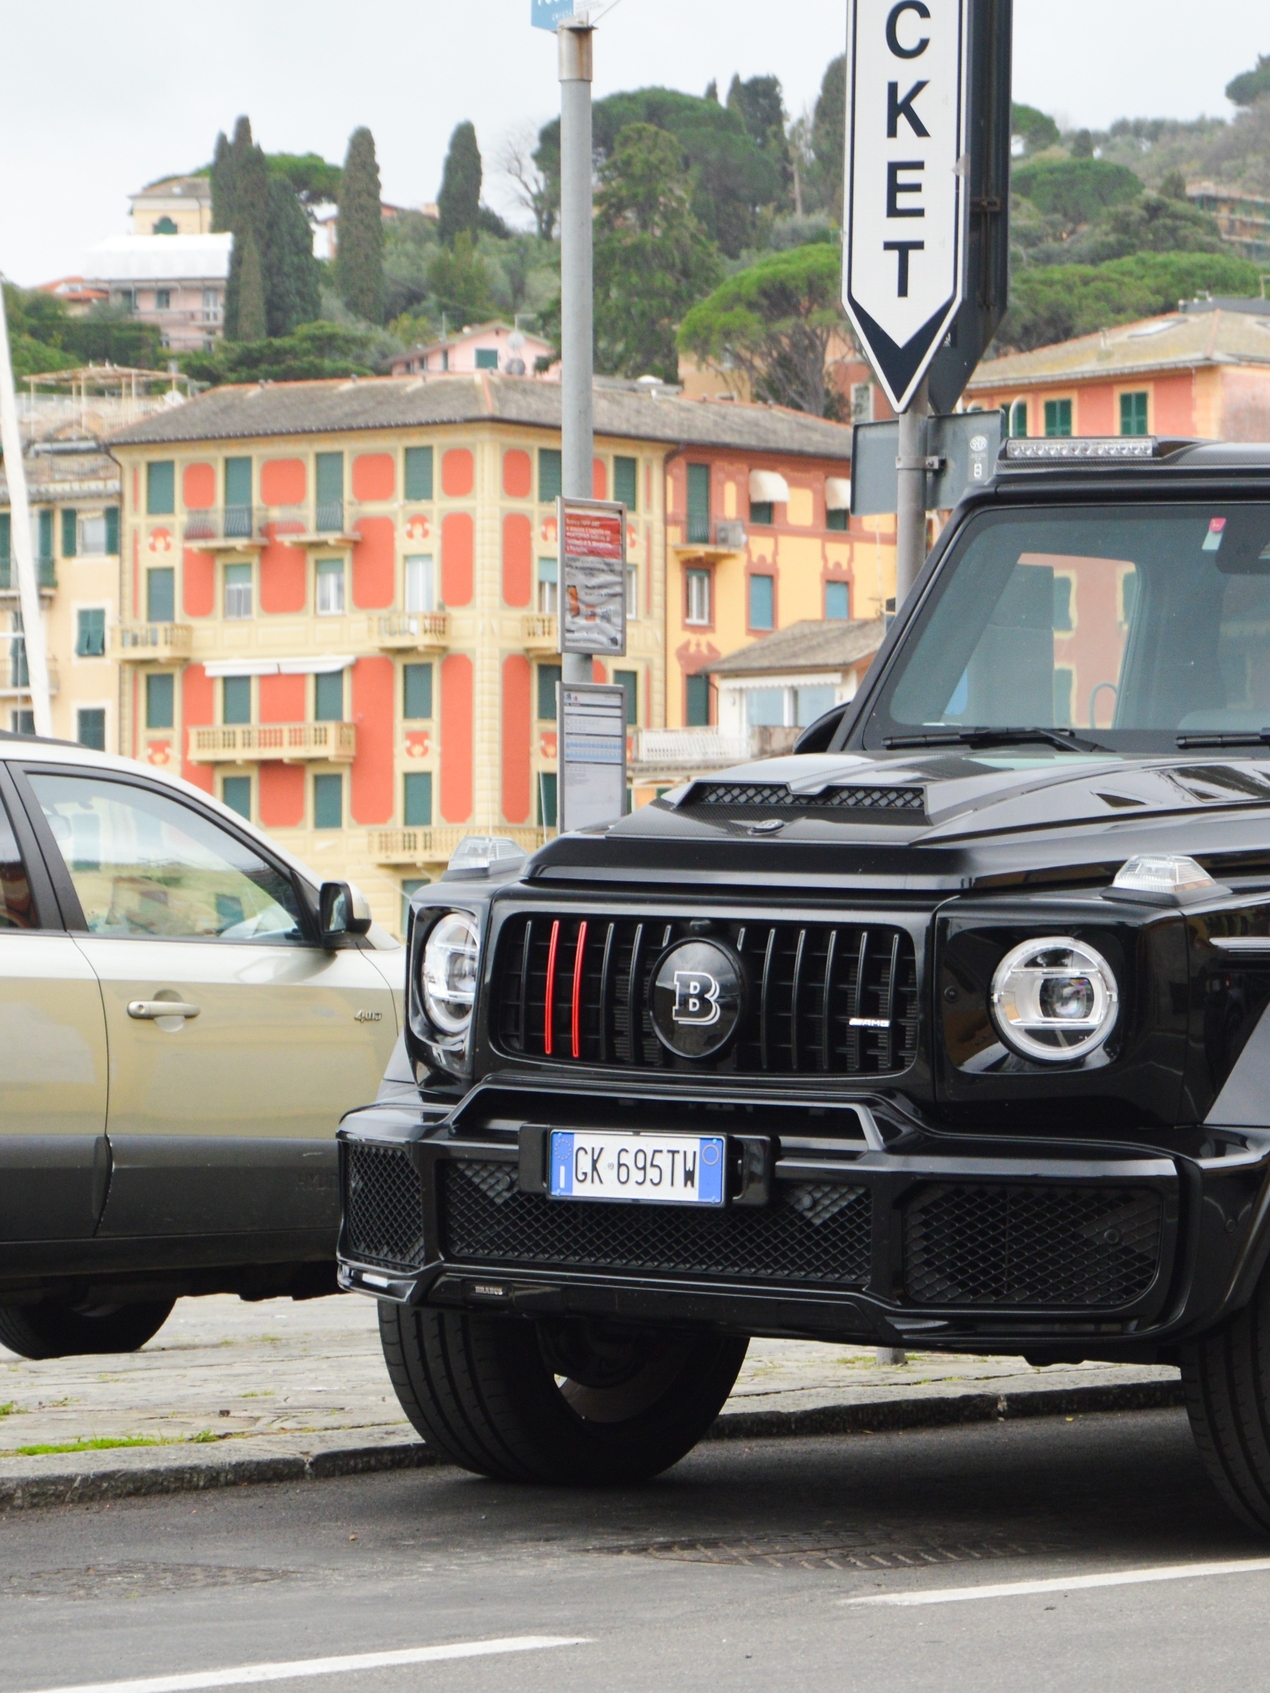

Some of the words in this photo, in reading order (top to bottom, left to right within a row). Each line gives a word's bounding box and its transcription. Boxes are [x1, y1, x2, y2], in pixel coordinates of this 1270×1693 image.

[672, 970, 721, 1027] B
[574, 1146, 605, 1185] GK
[616, 1147, 698, 1189] 695TW
